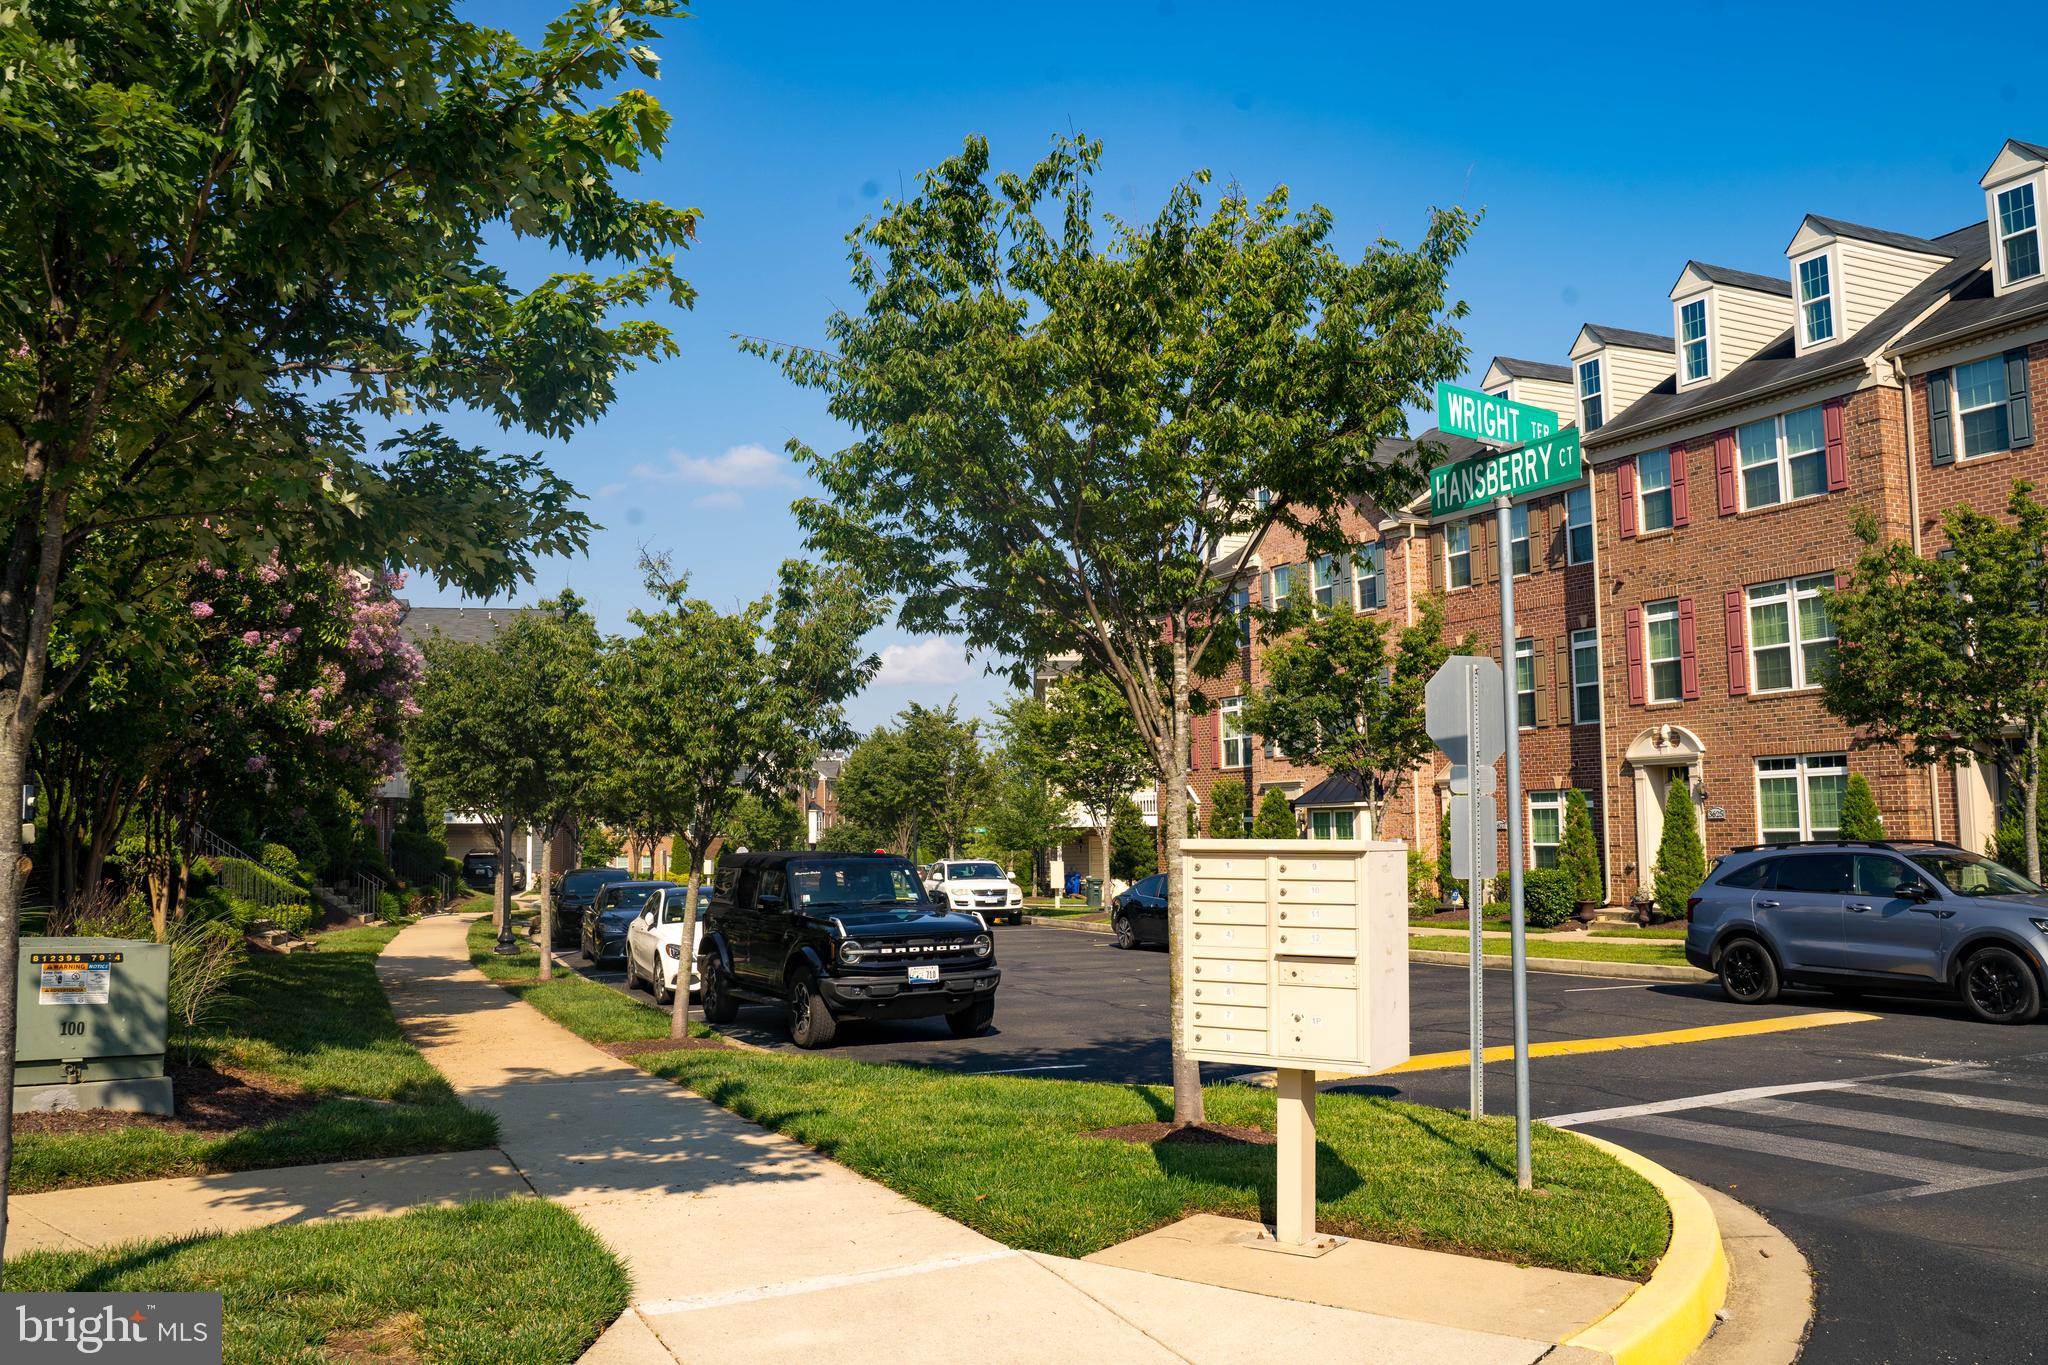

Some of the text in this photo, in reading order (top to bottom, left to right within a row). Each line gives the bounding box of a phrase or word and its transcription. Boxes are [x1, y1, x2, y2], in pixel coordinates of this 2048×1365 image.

[1448, 392, 1549, 442] WRIGHT TER
[1436, 443, 1573, 509] HANSBERRY CT
[881, 945, 960, 954] BRONCO
[32, 954, 81, 962] 812396
[60, 1021, 85, 1036] 100
